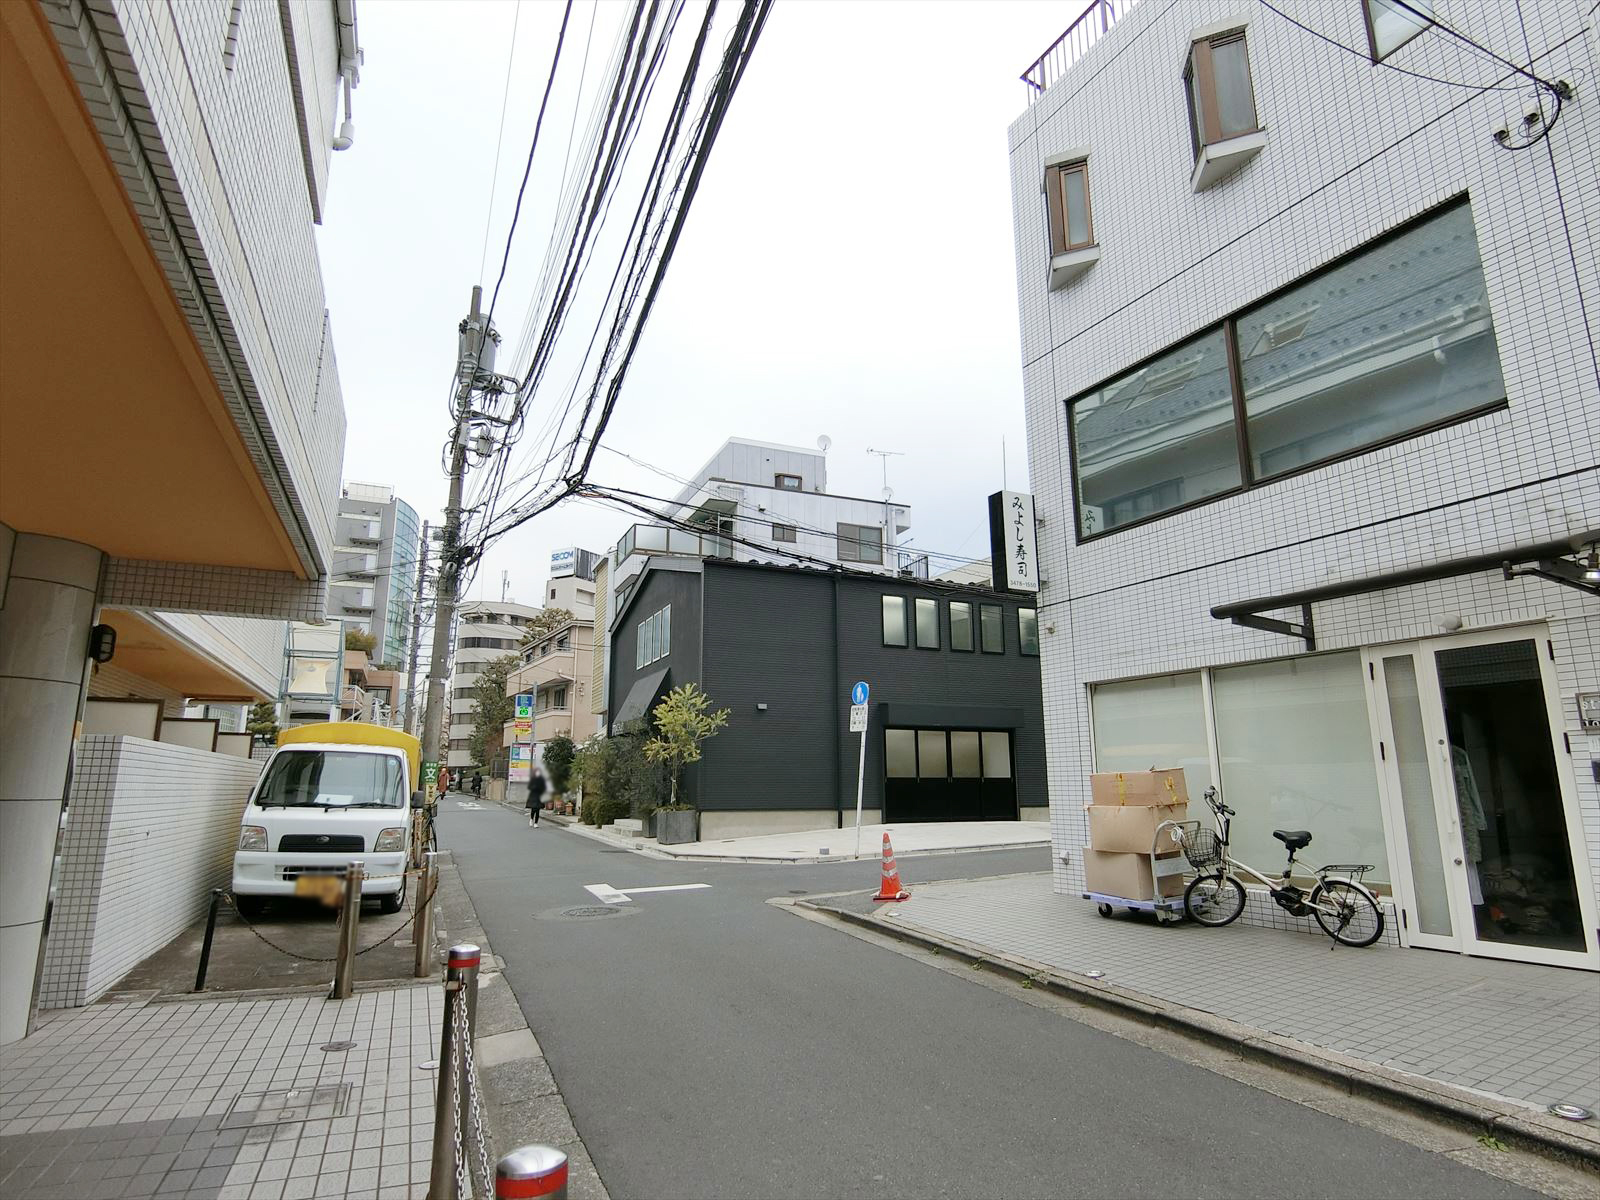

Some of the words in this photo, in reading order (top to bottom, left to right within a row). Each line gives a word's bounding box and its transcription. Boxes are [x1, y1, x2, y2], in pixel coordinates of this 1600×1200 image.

[1013, 497, 1027, 577] みよし寿司
[552, 550, 573, 561] SECOM
[424, 767, 436, 779] 文
